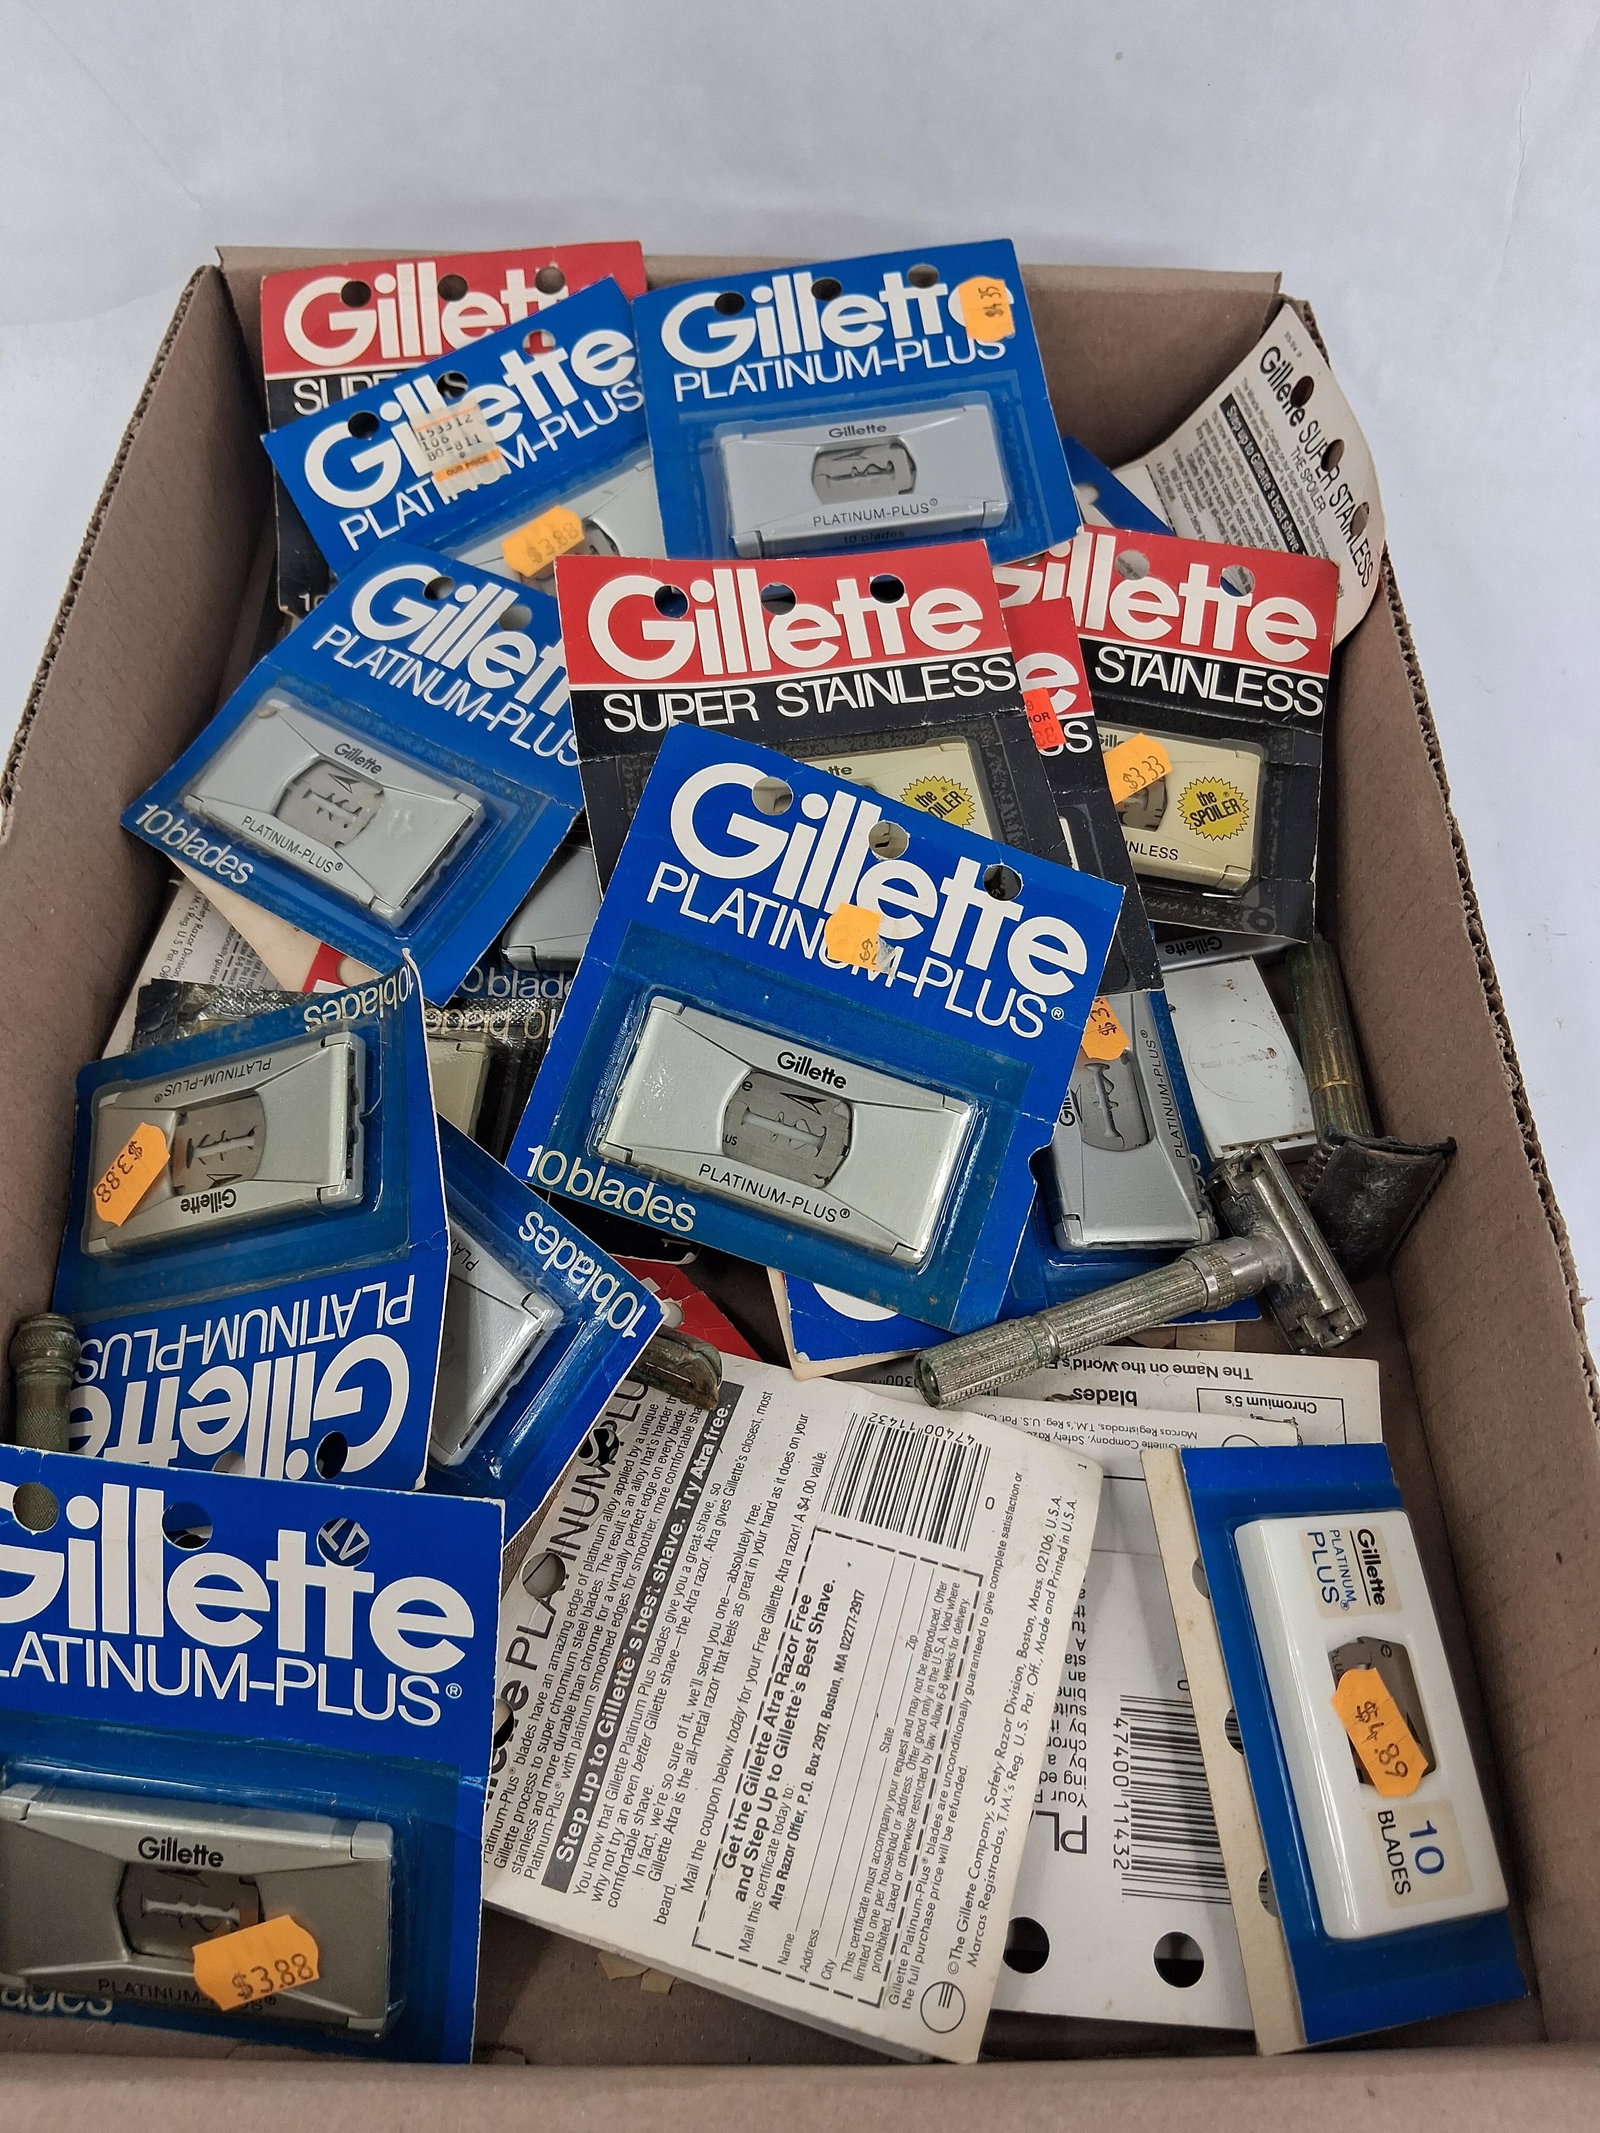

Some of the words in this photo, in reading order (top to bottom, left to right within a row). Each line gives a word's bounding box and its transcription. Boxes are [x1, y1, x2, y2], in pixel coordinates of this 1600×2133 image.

[284, 262, 568, 366] Gillet
[828, 423, 887, 439] Gillette
[1290, 448, 1306, 472] THE
[1300, 466, 1327, 515] SPOILER
[588, 567, 984, 680] Gillette
[603, 688, 759, 733] SUPER
[776, 656, 1017, 718] STAINLESS
[1095, 645, 1324, 718] STAINLESS
[333, 743, 383, 775] Gillette
[915, 789, 935, 810] the
[1190, 798, 1242, 829] SPOILER
[1196, 790, 1217, 805] the
[1124, 839, 1179, 861] NLESS
[670, 762, 1088, 996] Gillette
[1164, 936, 1223, 955] Gillette
[777, 1051, 847, 1090] Gillette
[96, 1139, 144, 1204] $3.88
[181, 1187, 237, 1213] Gillette
[1062, 1358, 1119, 1373] World's
[1121, 1361, 1146, 1374] the
[1150, 1363, 1169, 1373] on
[1173, 1363, 1219, 1379] Name
[1223, 1367, 1253, 1381] The
[1072, 1387, 1138, 1406] blades
[1224, 1394, 1243, 1407] 5's
[1246, 1396, 1317, 1414] Chromium
[710, 1401, 733, 1442] free.
[869, 1412, 915, 1431] 11432
[925, 1424, 975, 1446] 47400
[689, 1442, 715, 1480] Atra
[674, 1479, 705, 1515] Try
[1044, 1494, 1062, 1529] U.S.A.
[1060, 1498, 1078, 1532] U.S.A.
[652, 1518, 686, 1583] shave.
[1034, 1532, 1057, 1573] 02106,
[1057, 1534, 1070, 1545] in
[1046, 1543, 1068, 1589] Printed
[1307, 1531, 1340, 1605] PLUS
[1357, 1528, 1386, 1606] Gillette
[630, 1584, 661, 1633] best
[789, 1593, 812, 1633] Free
[807, 1579, 836, 1635] Shave.
[1026, 1577, 1044, 1612] Mass.
[1044, 1588, 1056, 1615] and
[838, 1588, 865, 1651] 02277-2917
[1015, 1614, 1037, 1659] Boston,
[1033, 1616, 1050, 1655] Made
[773, 1633, 800, 1686] Razor
[794, 1636, 819, 1678] Best
[832, 1653, 848, 1673] MA
[1025, 1657, 1044, 1686] Off.,
[596, 1636, 642, 1738] Gillette's
[819, 1676, 844, 1720] Boston,
[1002, 1662, 1027, 1715] Division,
[1019, 1690, 1035, 1715] Pat.
[762, 1689, 785, 1729] Atra
[772, 1680, 806, 1759] Gillette's
[811, 1721, 831, 1751] 2917,
[993, 1716, 1012, 1759] Razor
[1012, 1718, 1029, 1746] U.S.
[1355, 1700, 1409, 1779] $4.89
[587, 1743, 607, 1767] to
[742, 1730, 772, 1796] Gillette
[804, 1751, 821, 1776] Box
[1005, 1751, 1024, 1781] Reg.
[1113, 1717, 1130, 1787] 47400
[578, 1771, 599, 1802] up
[765, 1763, 783, 1782] to
[780, 1782, 795, 1800] to:
[983, 1760, 1006, 1806] Safety
[756, 1785, 778, 1812] Up
[796, 1780, 814, 1805] P.O.
[820, 1957, 837, 1980] City
[878, 1725, 895, 1753] State
[904, 1633, 919, 1650] Zip
[995, 1784, 1015, 1821] T.M.'s
[1050, 1790, 1087, 1807] Your
[732, 1800, 752, 1831] the
[770, 1800, 792, 1835] today
[786, 1809, 808, 1841] Offer,
[137, 1836, 224, 1868] Gillette
[555, 1807, 588, 1862] Step
[721, 1833, 743, 1869] Get
[742, 1816, 769, 1861] Step
[967, 1810, 995, 1880] Company,
[1113, 1800, 1131, 1871] 11432
[1377, 1810, 1412, 1896] BLADES
[1409, 1819, 1445, 1875] 10
[754, 1837, 780, 1898] certificate
[775, 1842, 796, 1881] Razor
[976, 1826, 1008, 1911] Registradas,
[734, 1863, 754, 1902] and
[767, 1882, 786, 1911] Atra
[746, 1899, 763, 1923] this
[955, 1882, 977, 1932] Gillette
[737, 1924, 755, 1952] Mail
[777, 1932, 796, 1965] Name
[799, 1927, 820, 1973] Address
[965, 1913, 987, 1968] Marcas
[230, 1953, 315, 1999] $3.88
